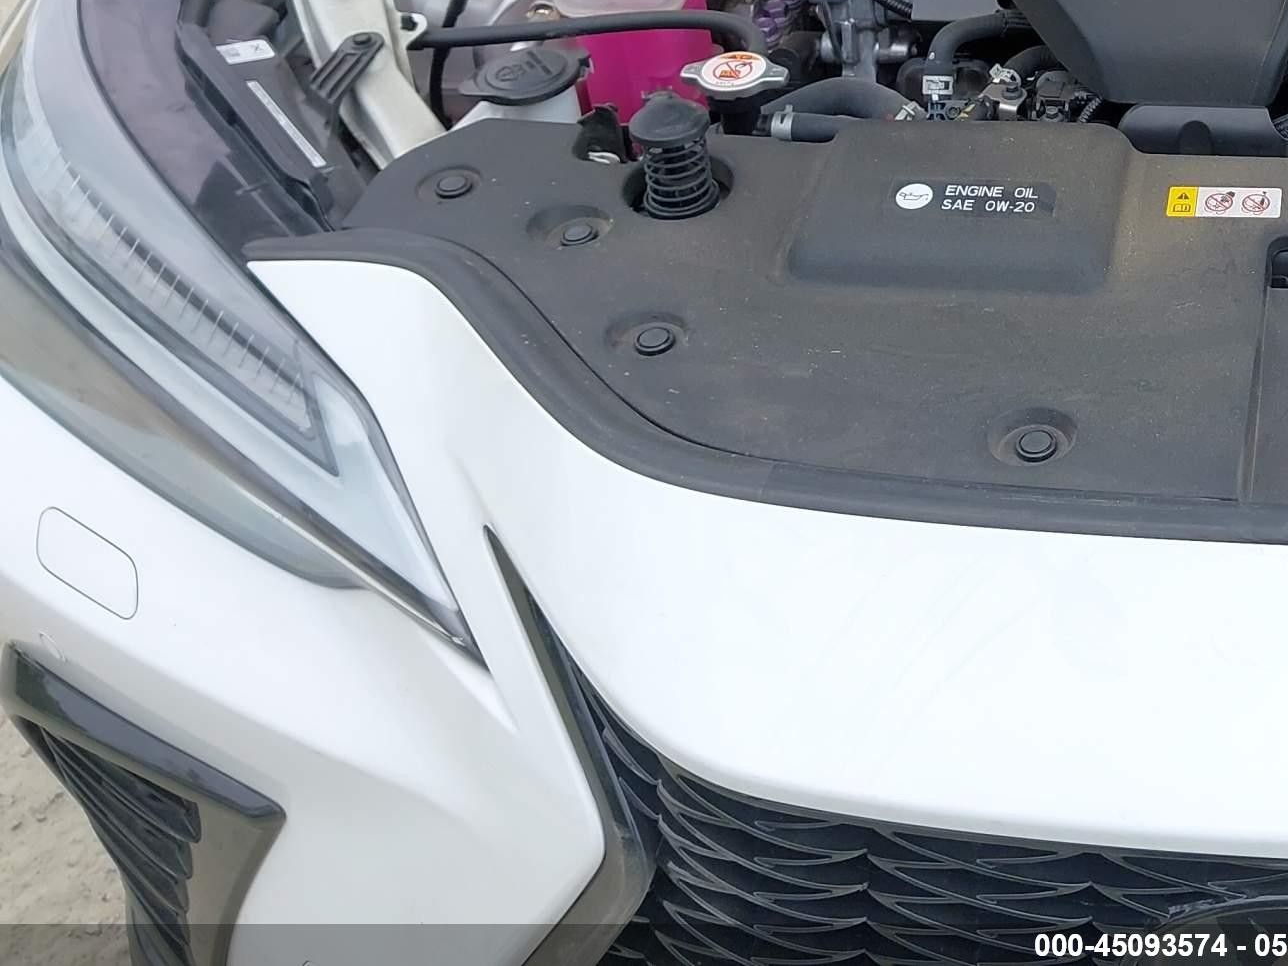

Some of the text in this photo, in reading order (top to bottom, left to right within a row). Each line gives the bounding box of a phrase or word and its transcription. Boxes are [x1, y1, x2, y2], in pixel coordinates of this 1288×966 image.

[945, 185, 1039, 199] ENGINE OIL
[941, 199, 975, 211] SAE
